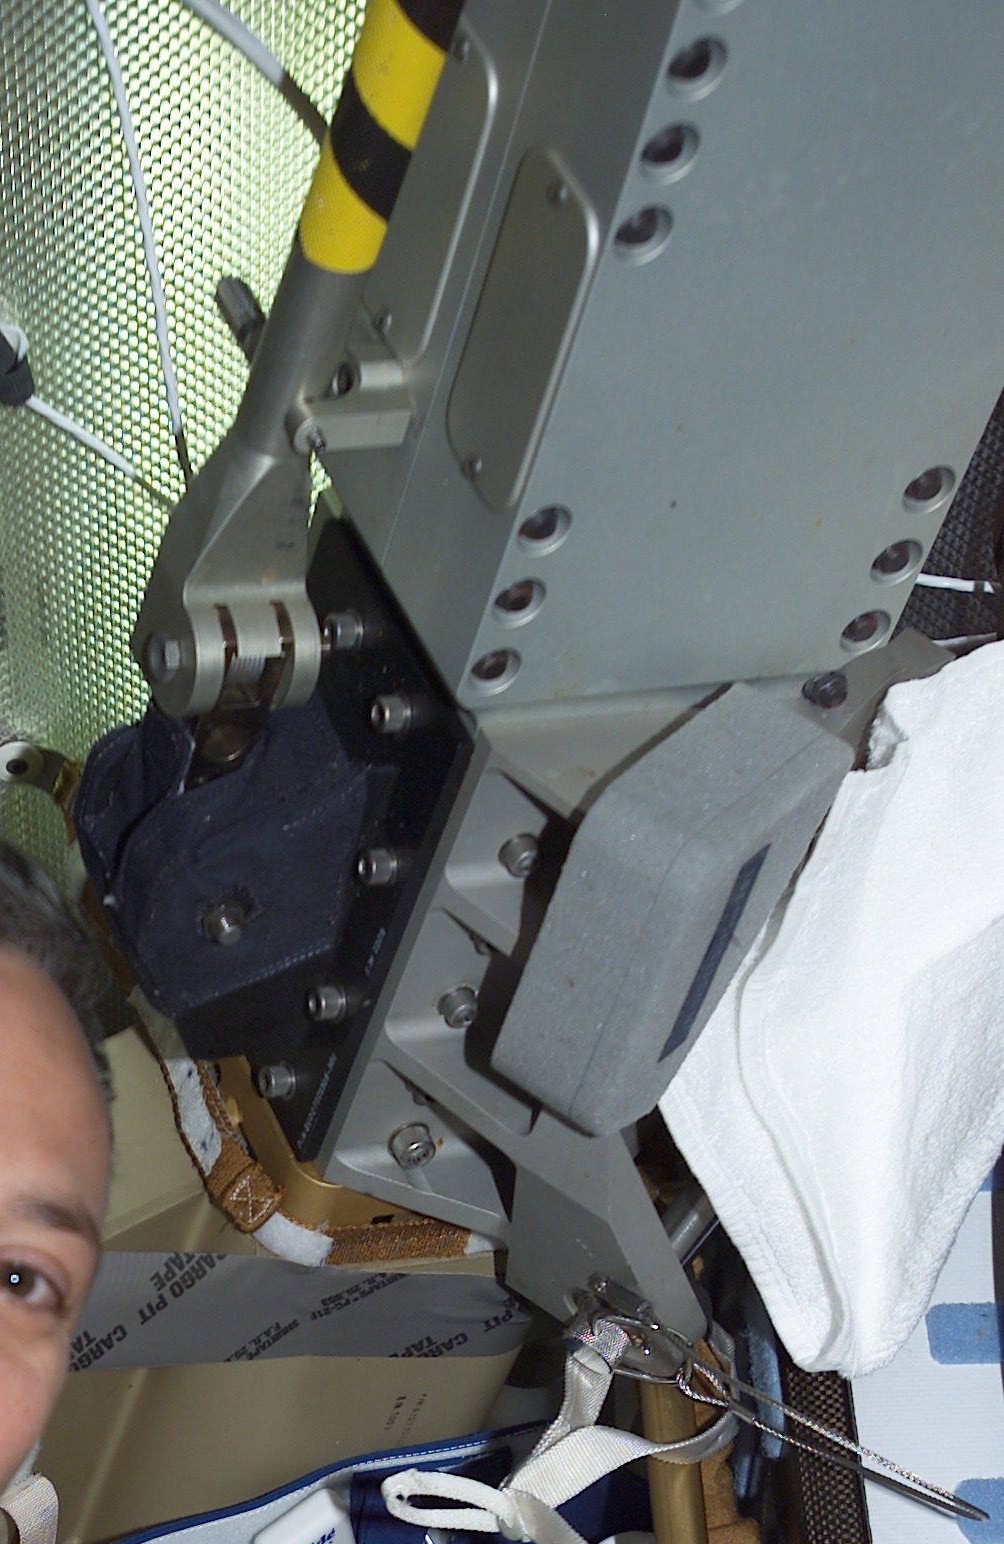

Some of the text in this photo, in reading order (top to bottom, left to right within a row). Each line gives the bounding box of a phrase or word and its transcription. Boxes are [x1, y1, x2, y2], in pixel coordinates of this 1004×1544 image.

[137, 1293, 168, 1325] PIT
[484, 1309, 514, 1333] PIT
[415, 1332, 469, 1357] CAR
